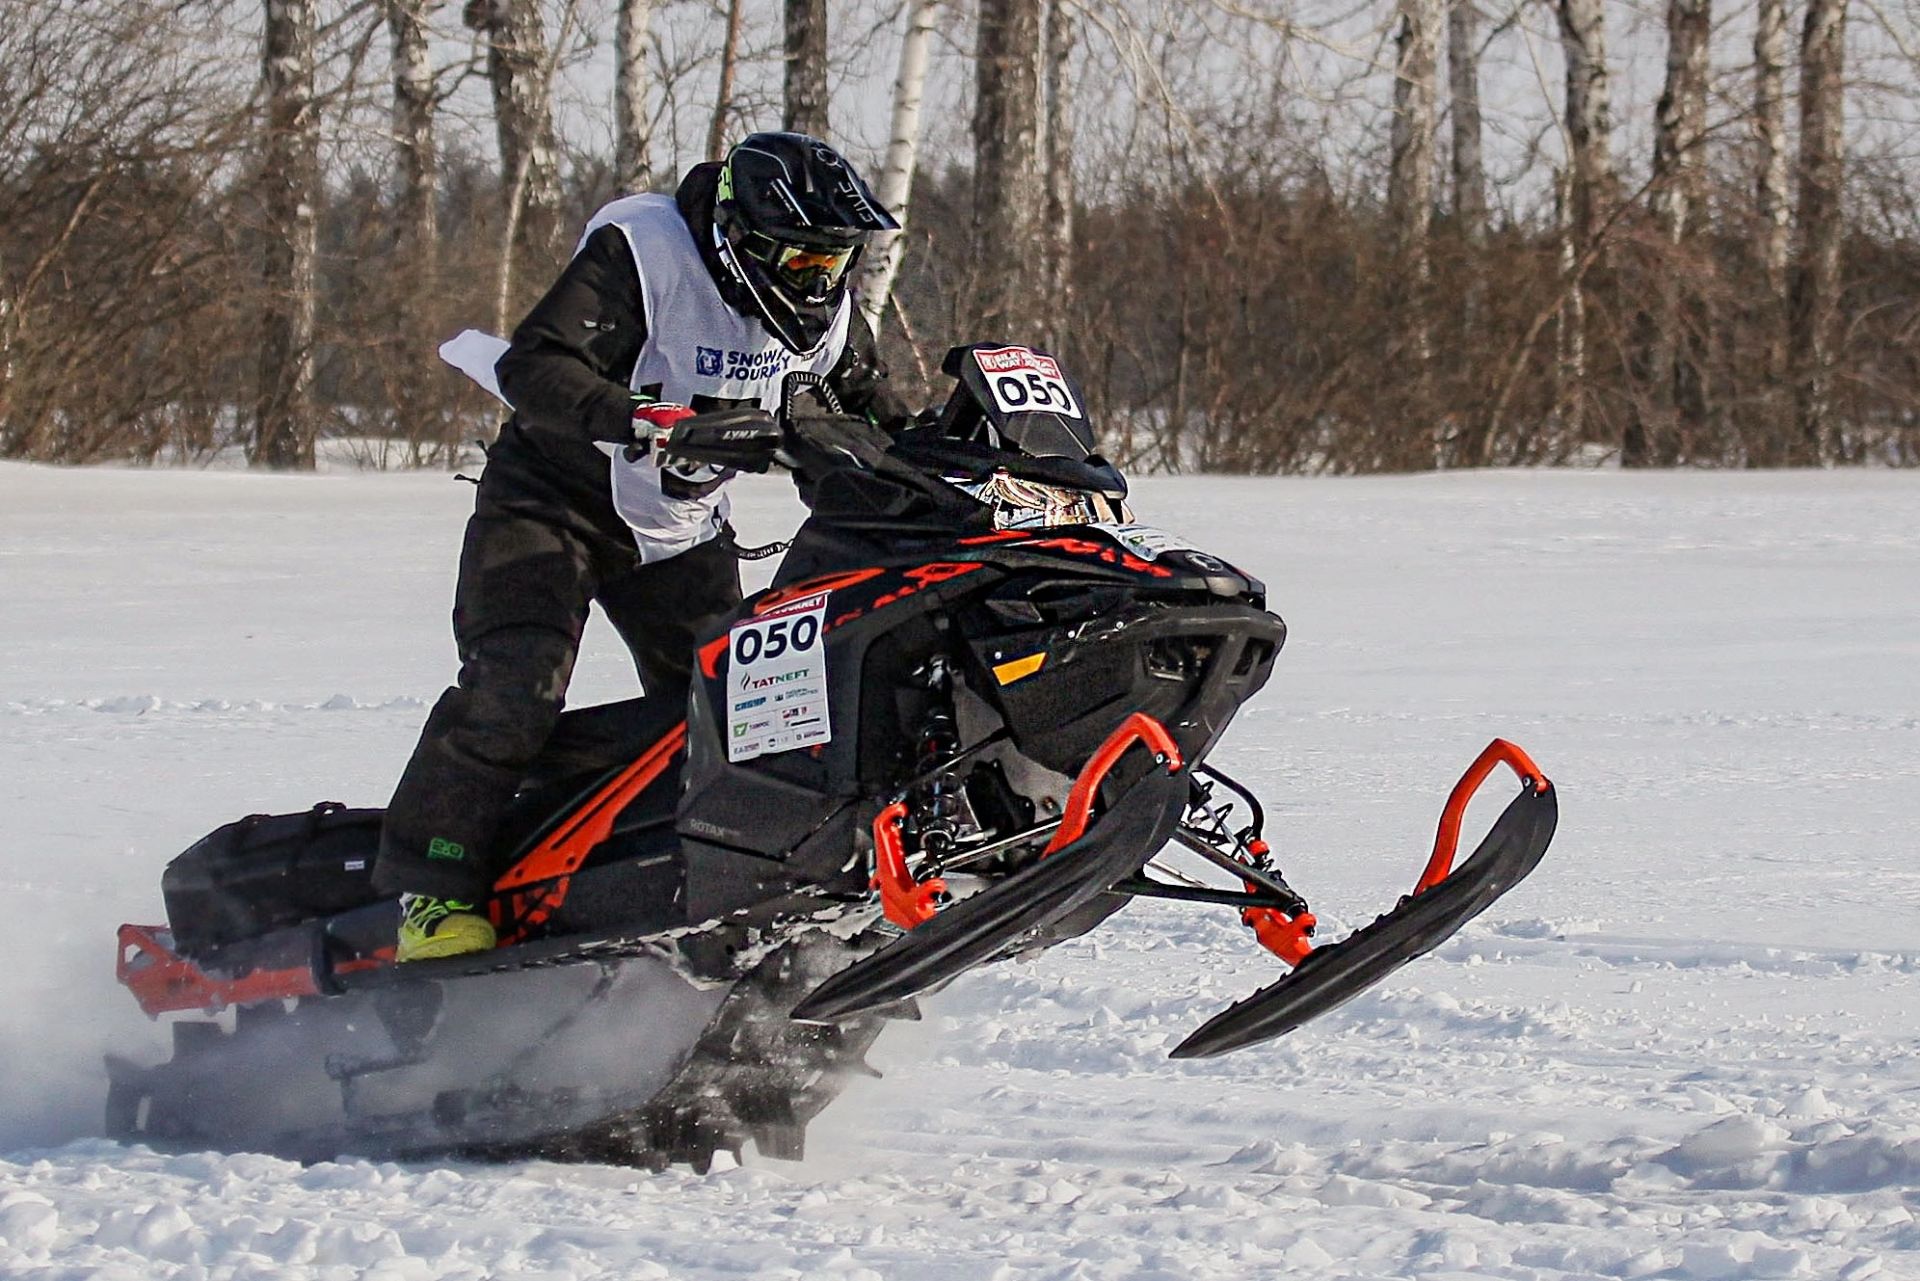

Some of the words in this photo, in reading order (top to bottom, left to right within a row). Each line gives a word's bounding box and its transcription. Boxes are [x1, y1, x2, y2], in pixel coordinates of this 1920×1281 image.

[997, 374, 1071, 412] 050
[721, 429, 760, 440] LYNX
[735, 615, 818, 665] 050
[751, 669, 810, 689] TATNEFT
